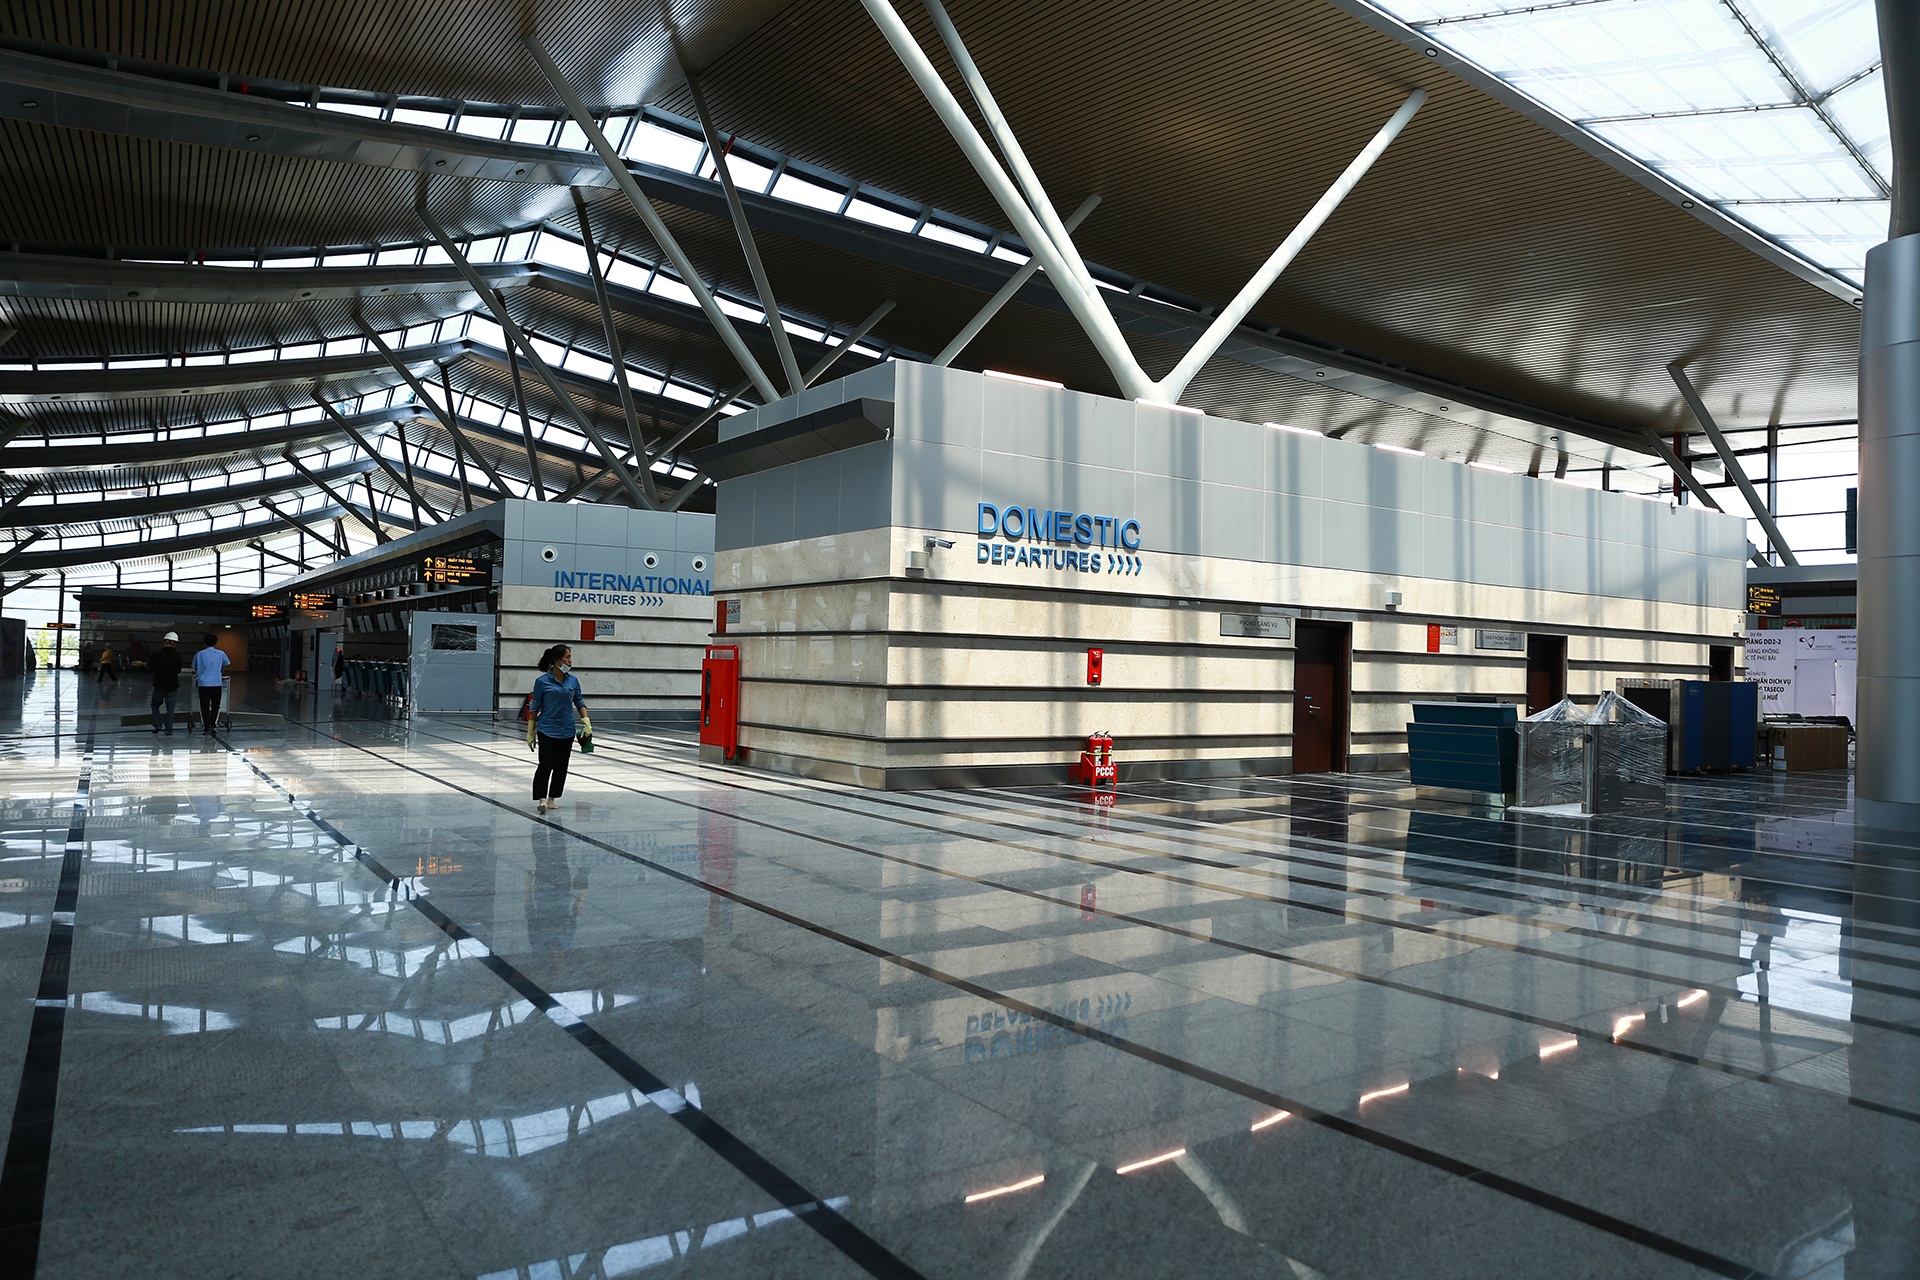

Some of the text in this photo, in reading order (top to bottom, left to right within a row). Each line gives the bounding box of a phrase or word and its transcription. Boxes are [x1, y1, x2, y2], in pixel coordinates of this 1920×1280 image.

[978, 502, 1141, 549] DOMESTIC
[978, 542, 1102, 572] DEPARTURES
[555, 570, 711, 596] INTERNATIONAL
[555, 591, 636, 605] DEPARTURES
[1095, 766, 1114, 777] PCCC
